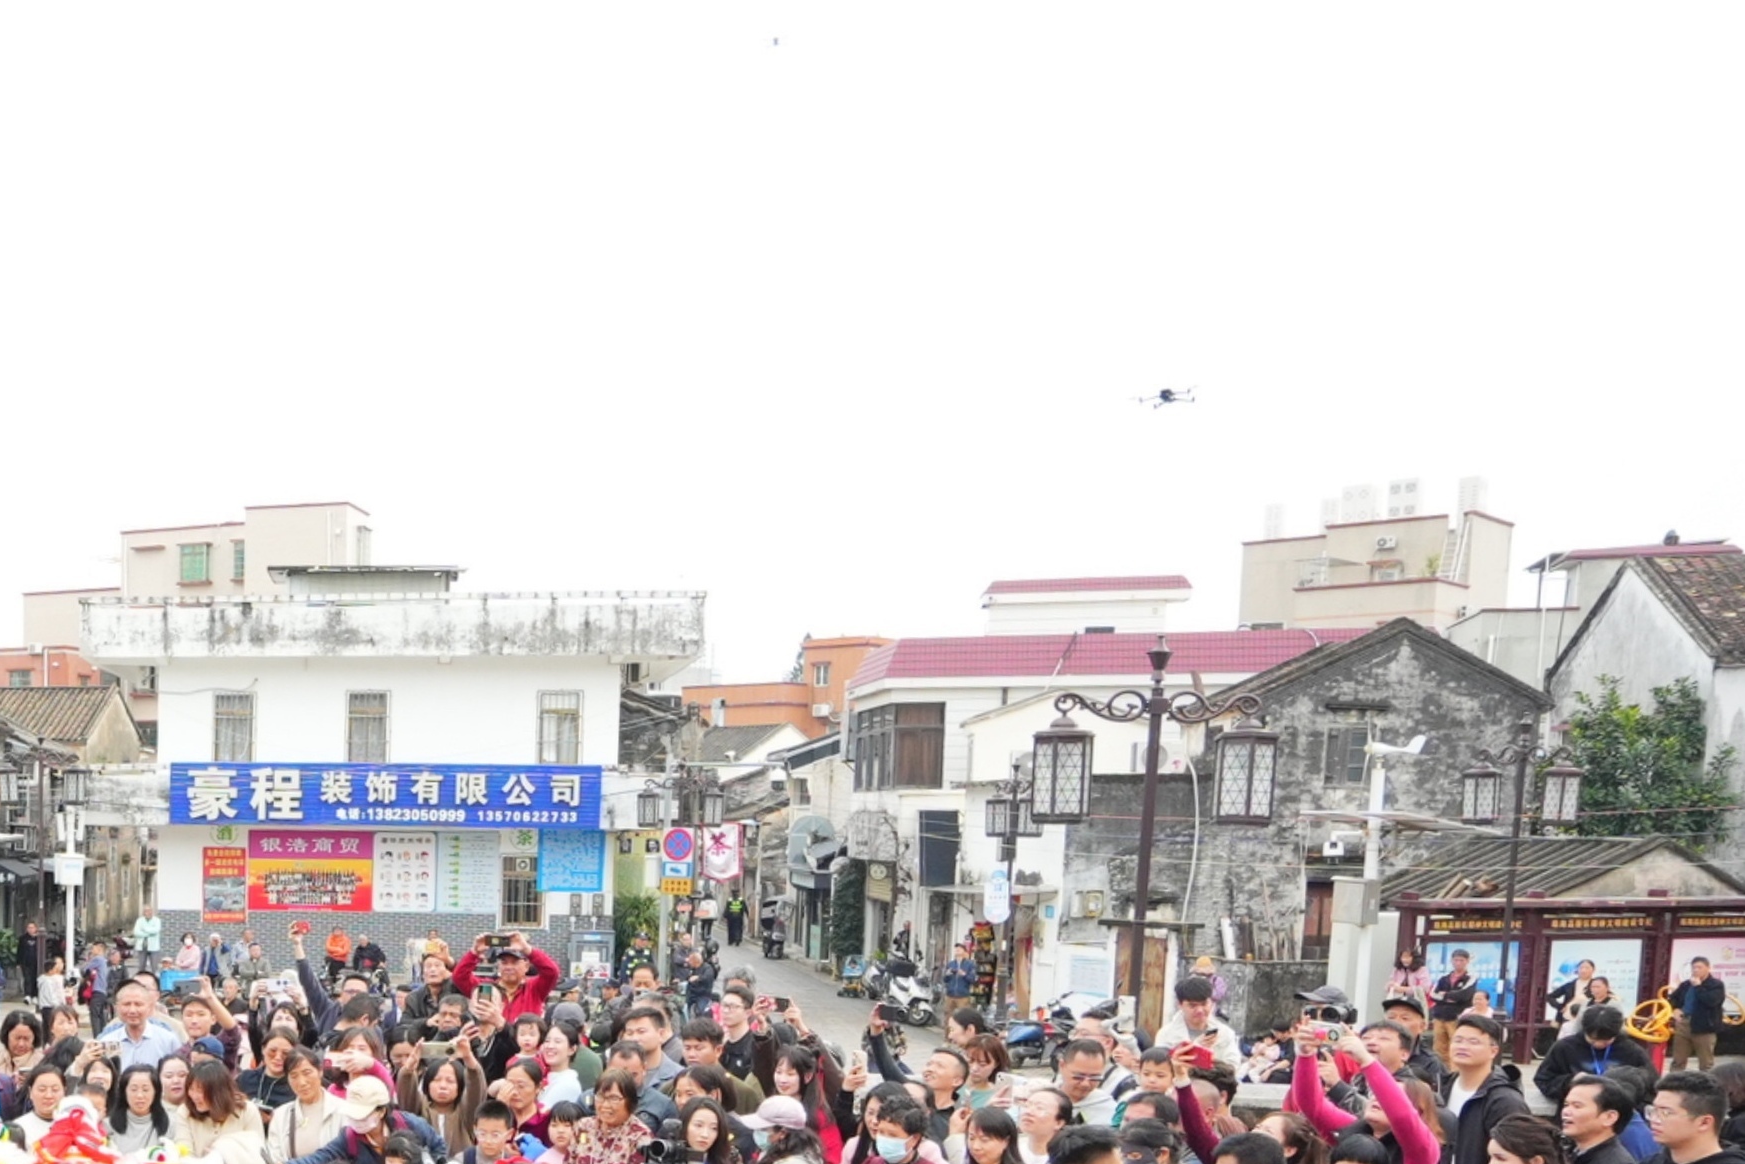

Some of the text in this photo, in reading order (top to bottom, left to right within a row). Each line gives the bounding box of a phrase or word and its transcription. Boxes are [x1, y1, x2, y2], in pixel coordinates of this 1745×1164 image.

[186, 766, 581, 822] 豪程 装饰有限公司
[477, 810, 578, 824] 13570622733
[258, 837, 361, 855] 银浩商贸
[707, 831, 733, 857] 茶
